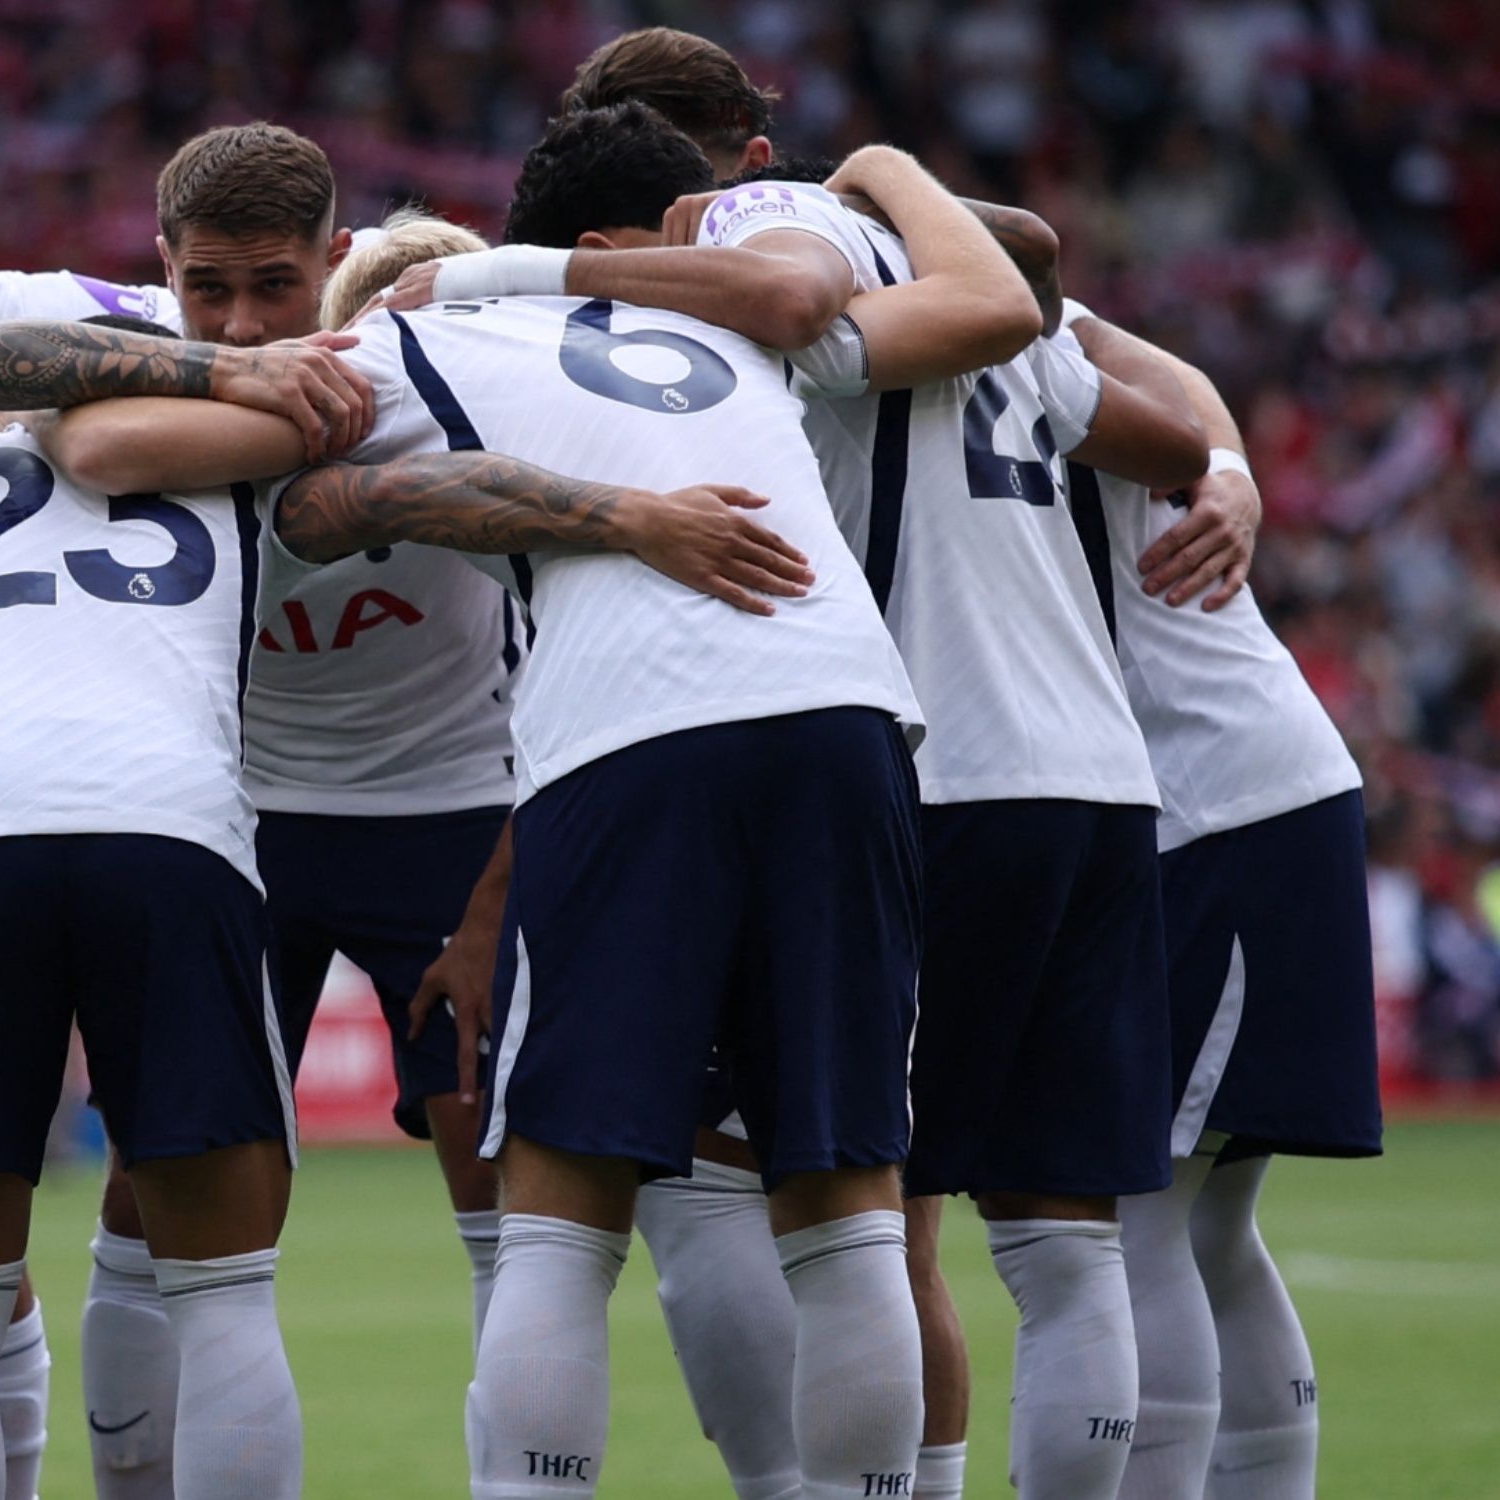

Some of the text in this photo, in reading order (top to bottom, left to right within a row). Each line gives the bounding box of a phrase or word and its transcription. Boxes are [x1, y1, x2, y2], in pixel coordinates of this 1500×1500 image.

[559, 297, 739, 415] 6
[258, 588, 426, 654] IA
[1087, 1416, 1135, 1443] THFC
[522, 1450, 592, 1482] THFC
[860, 1472, 912, 1497] THFC
